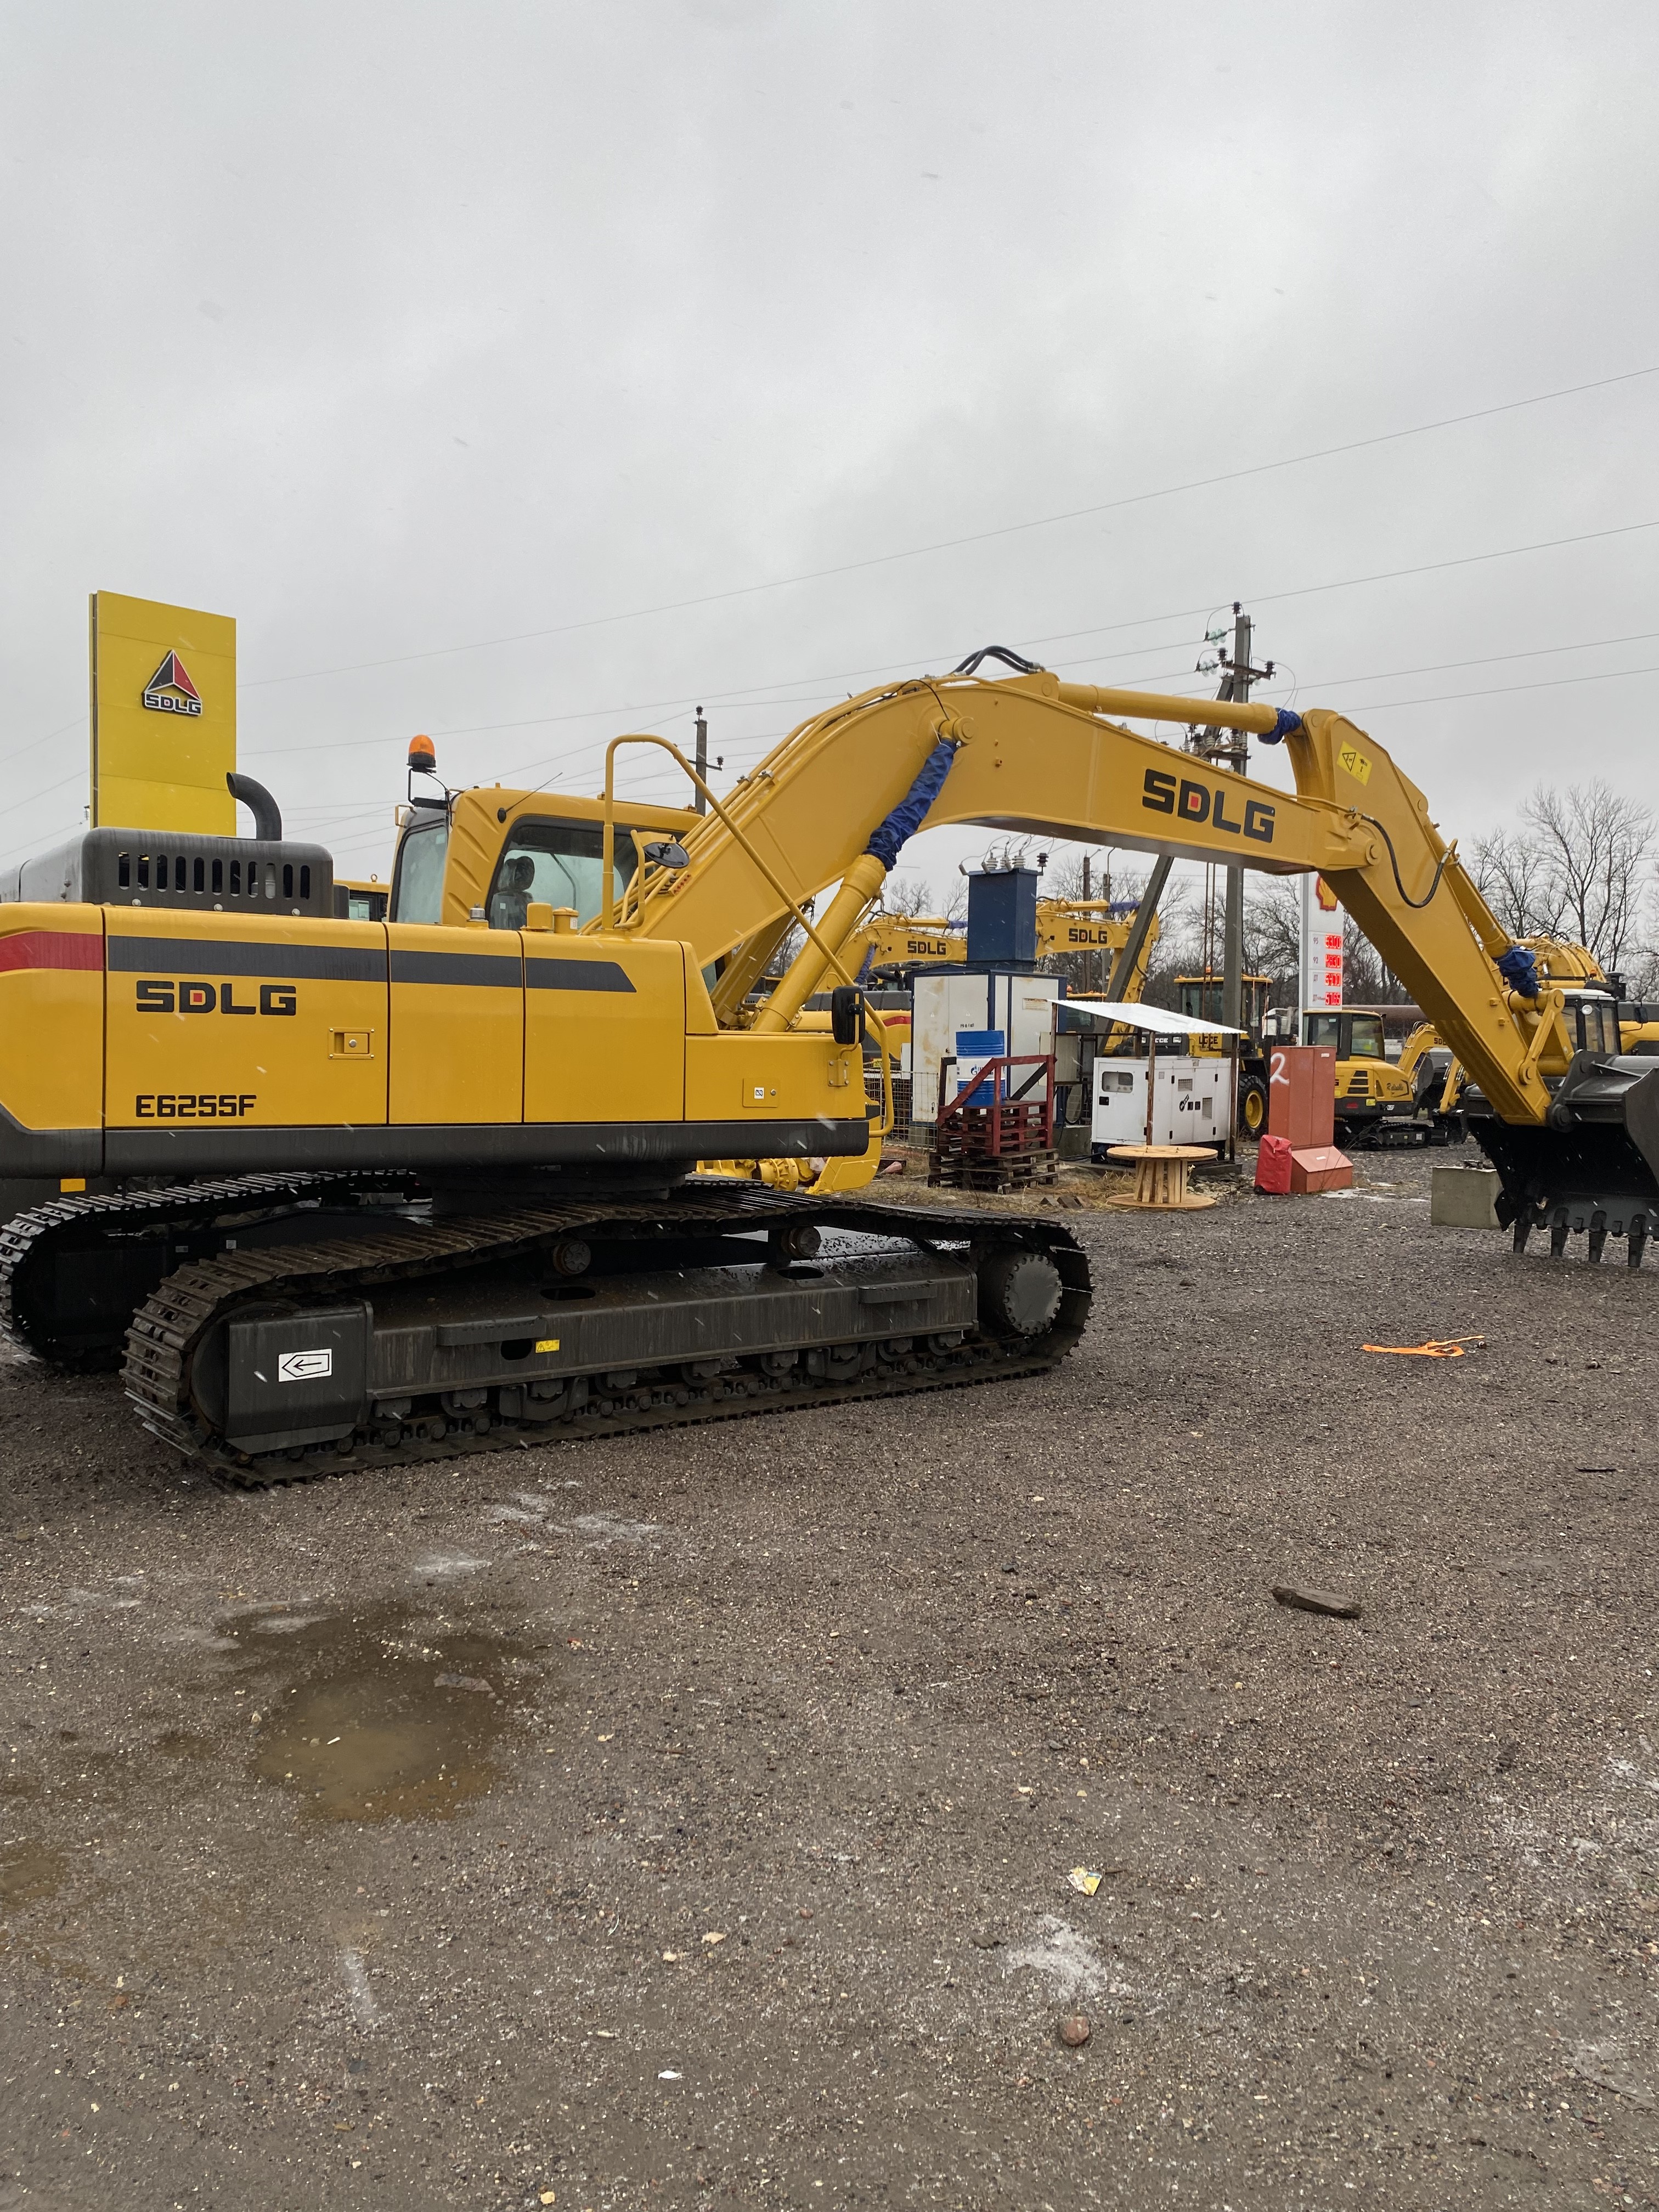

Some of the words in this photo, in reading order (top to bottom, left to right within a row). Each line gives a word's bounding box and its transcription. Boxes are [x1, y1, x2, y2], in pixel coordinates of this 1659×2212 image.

[145, 692, 202, 715] SDLG
[1142, 768, 1276, 843] SDLG
[907, 940, 946, 955] SDLG
[1069, 928, 1107, 944] SDLG
[136, 980, 297, 1016] SDLG
[1269, 1052, 1290, 1086] 2
[136, 1094, 257, 1118] E6255F
